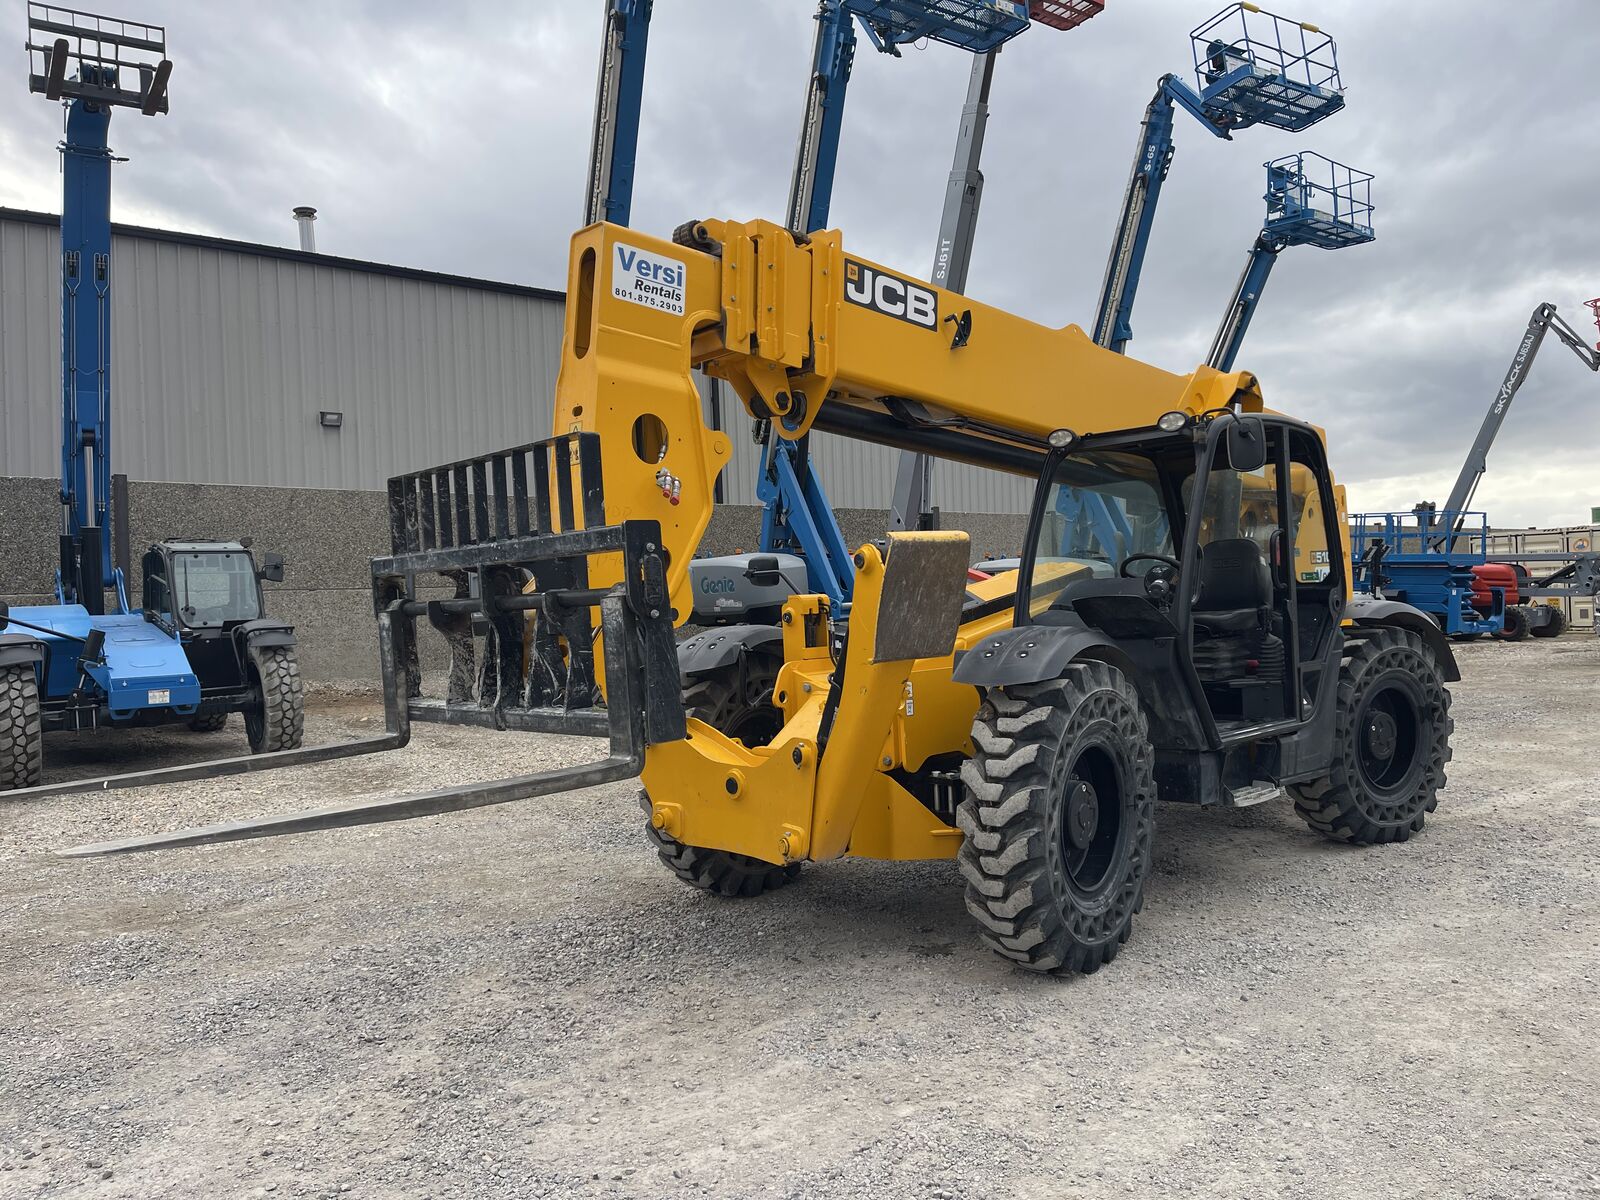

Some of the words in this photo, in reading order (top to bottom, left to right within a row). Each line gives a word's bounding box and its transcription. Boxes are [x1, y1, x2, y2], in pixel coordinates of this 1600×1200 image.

[1144, 145, 1156, 172] S-65
[617, 246, 683, 288] Versi
[936, 238, 951, 279] SJ61T
[615, 288, 683, 313] 801.875.2903
[634, 279, 682, 302] Rentals
[847, 269, 936, 326] JCB
[1494, 364, 1522, 415] SKYJACK
[1516, 334, 1535, 362] SJ63AJ
[701, 576, 735, 594] Genie
